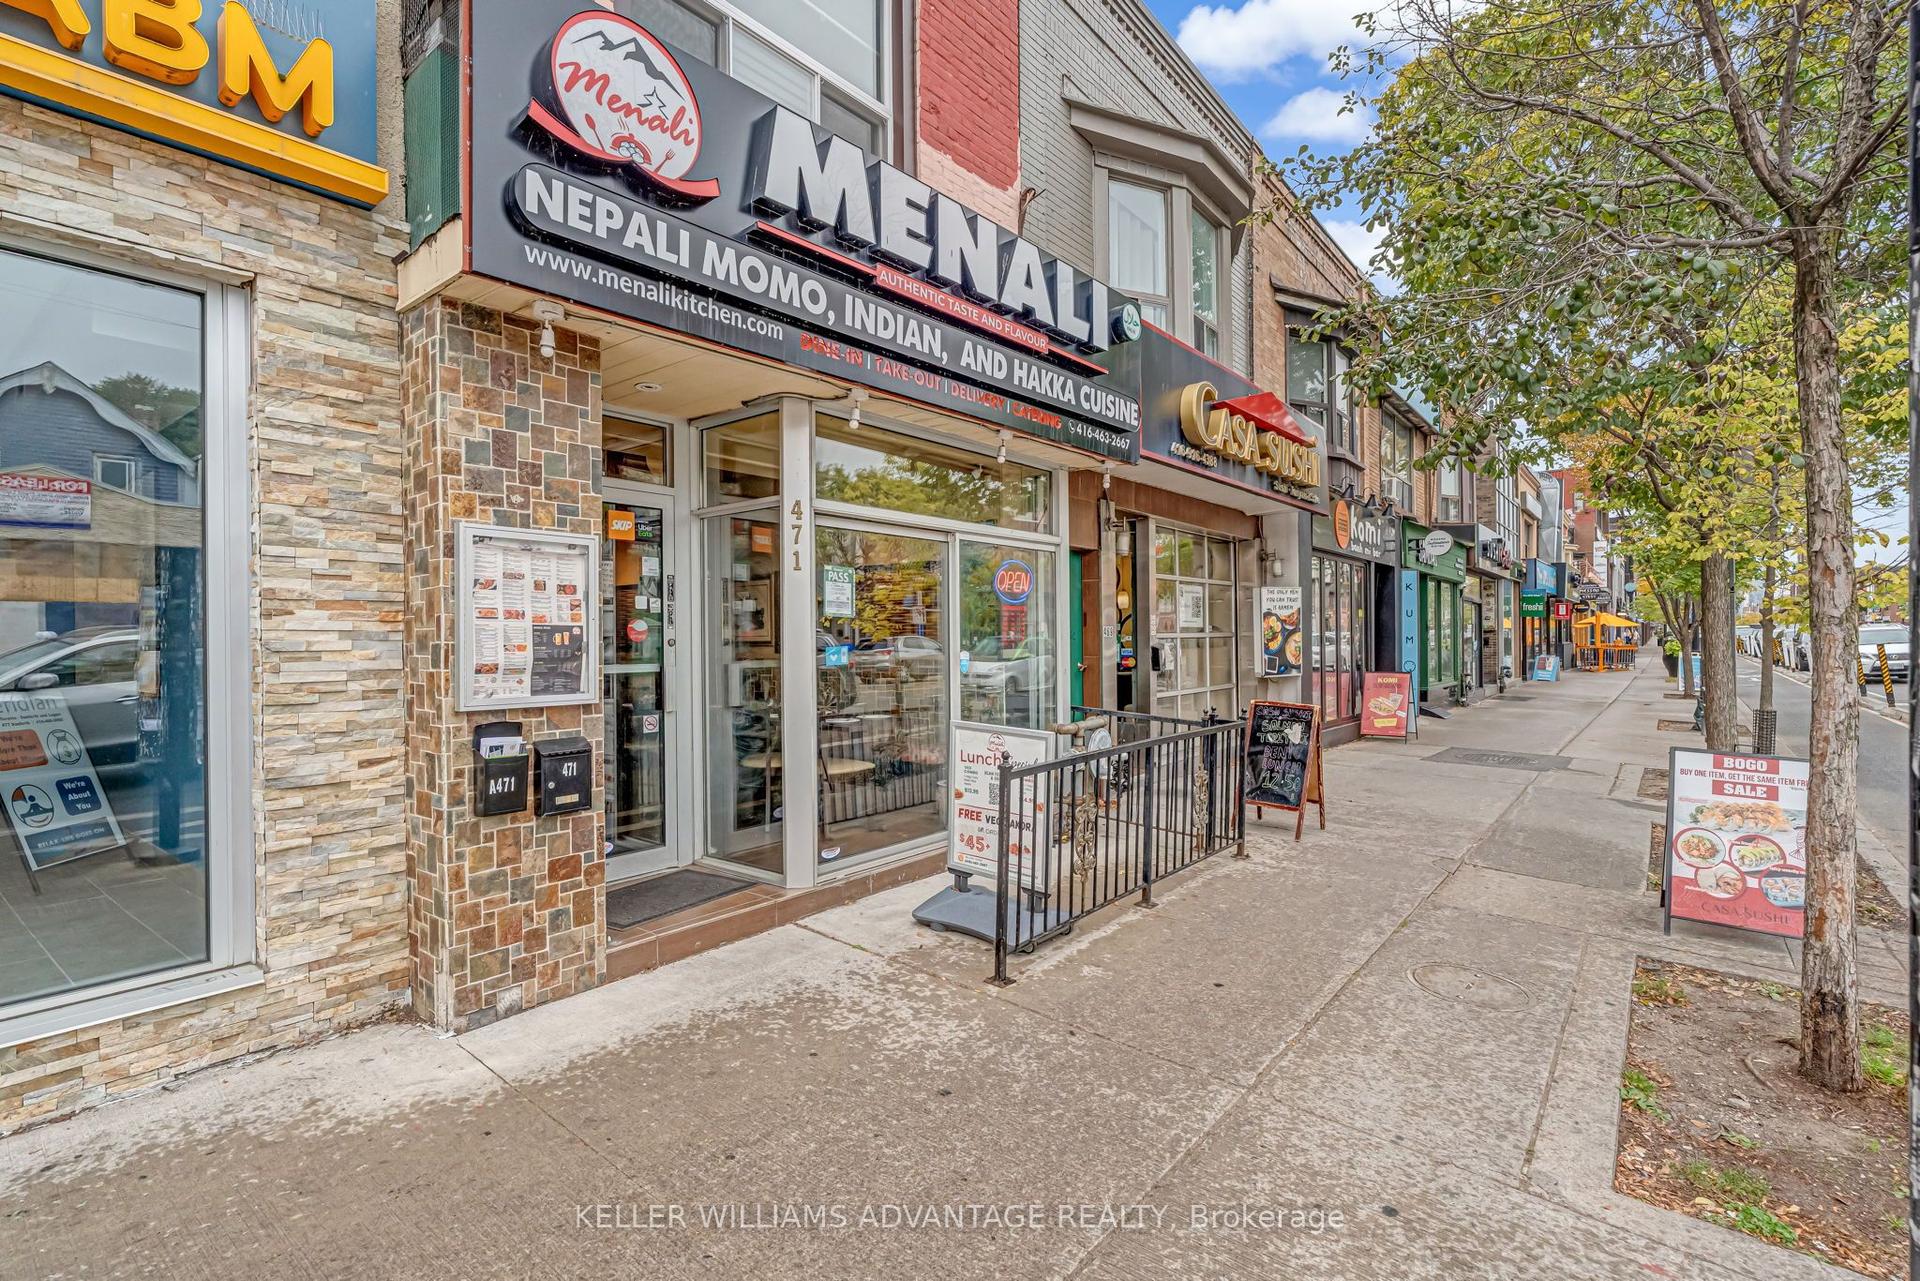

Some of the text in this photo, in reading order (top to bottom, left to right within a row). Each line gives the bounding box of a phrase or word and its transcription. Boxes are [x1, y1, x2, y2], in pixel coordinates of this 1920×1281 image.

[559, 62, 694, 146] Menali
[757, 104, 1110, 352] MENALI
[524, 244, 783, 341] www.menalikitchen.com
[525, 169, 1138, 426] NEPALI MOMO, INDIAN, AND HAKKA CUISINE
[879, 270, 1046, 349] AUTHENTIC TASTE AND FLAVOUR
[800, 332, 1062, 430] DINE-IN TAKE-OUT DELIVERY CATERING
[1076, 423, 1130, 450] 416-463-2667
[1184, 381, 1321, 488] CASA SUSHI
[611, 519, 633, 531] SKIP
[638, 523, 653, 531] Uber
[639, 530, 653, 538] Eats
[829, 571, 849, 583] PASS
[997, 571, 1030, 592] OPEN
[1522, 602, 1544, 612] freshii
[960, 749, 1001, 767] Lunch
[1723, 757, 1768, 772] BOGO
[562, 762, 577, 776] 471
[1680, 768, 1693, 776] BUY
[1694, 770, 1707, 778] ONE
[1728, 773, 1740, 781] GET
[1743, 774, 1756, 782] THE
[1757, 775, 1777, 784] SAME
[1777, 777, 1795, 786] ITEM
[63, 780, 87, 790] We're
[489, 776, 515, 795] A471
[1723, 783, 1768, 798] SALE
[68, 791, 91, 801] About
[76, 802, 92, 810] You
[958, 808, 983, 822] FREE
[1701, 902, 1739, 915] CASA
